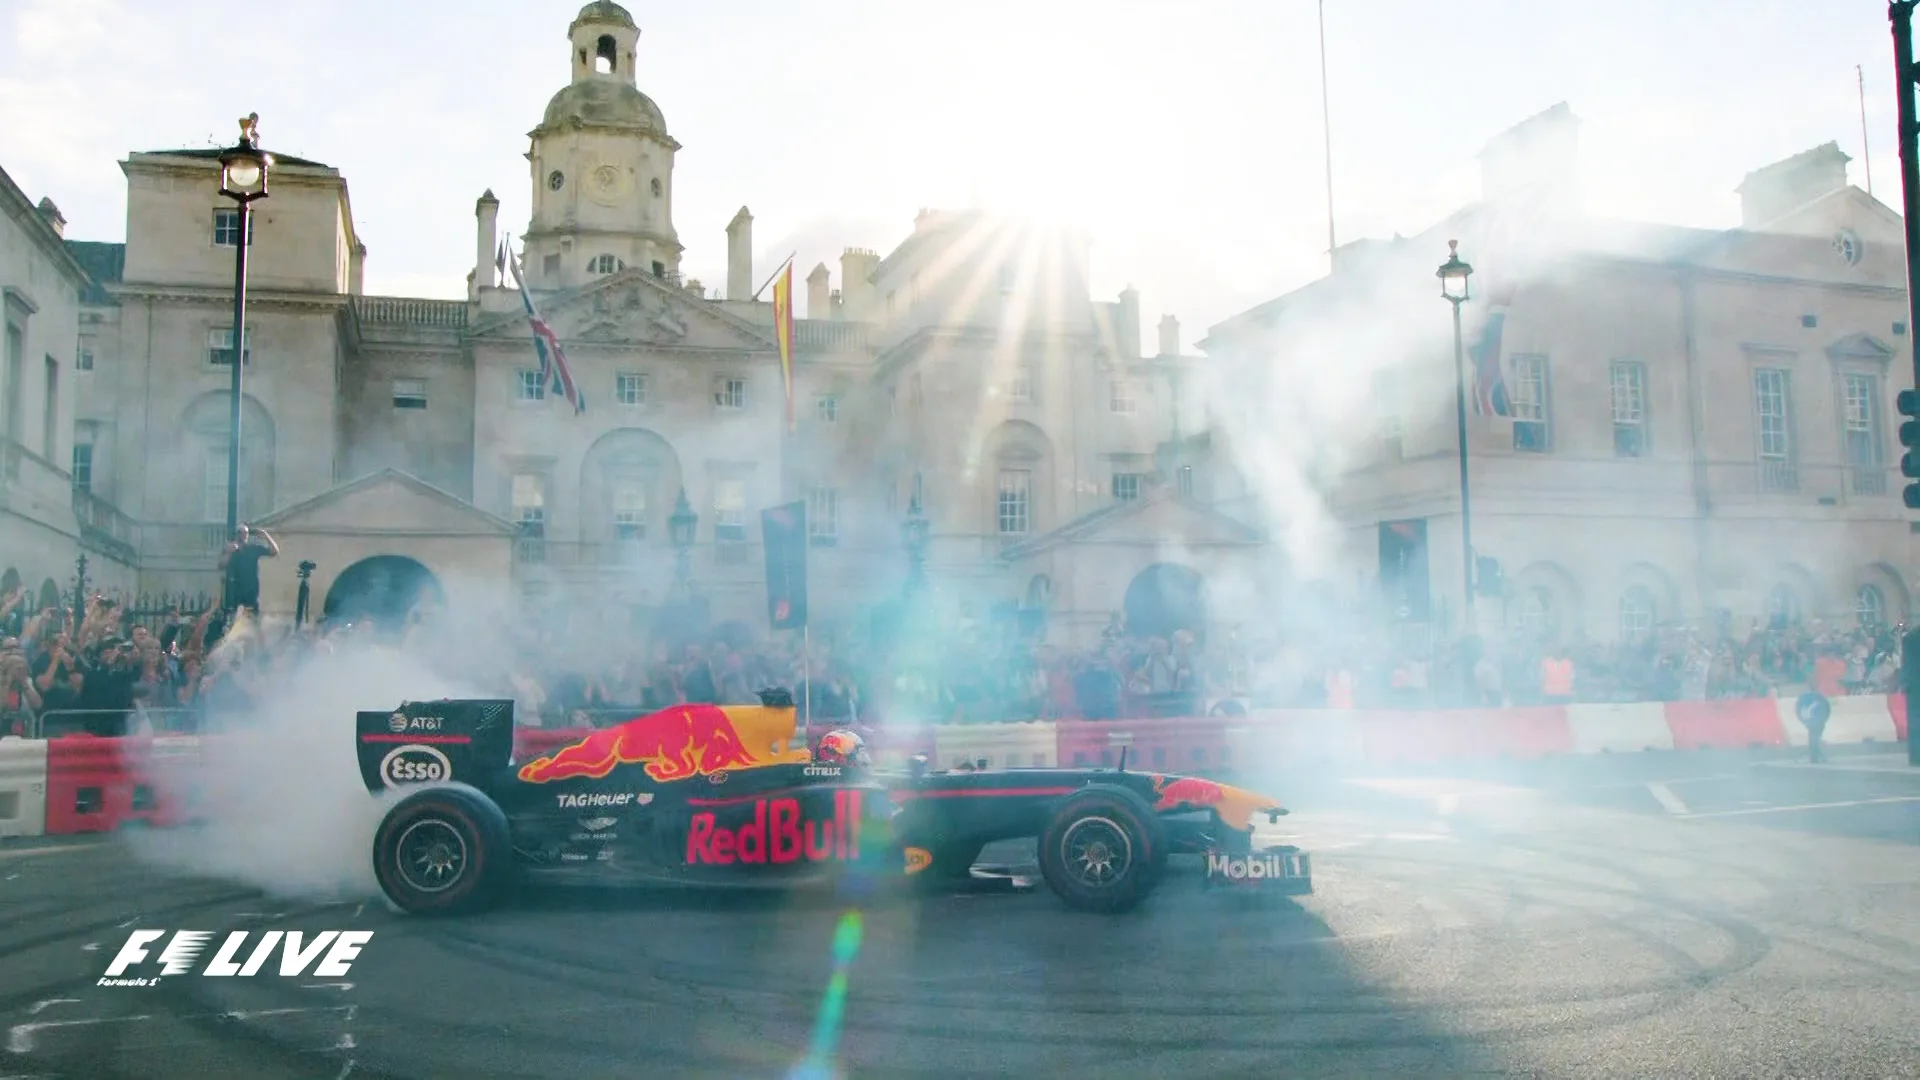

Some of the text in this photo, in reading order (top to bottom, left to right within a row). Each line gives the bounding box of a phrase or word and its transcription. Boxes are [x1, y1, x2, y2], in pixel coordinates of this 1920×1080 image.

[410, 717, 444, 730] AT&T
[392, 757, 440, 780] Esso
[1207, 854, 1280, 879] Mobil
